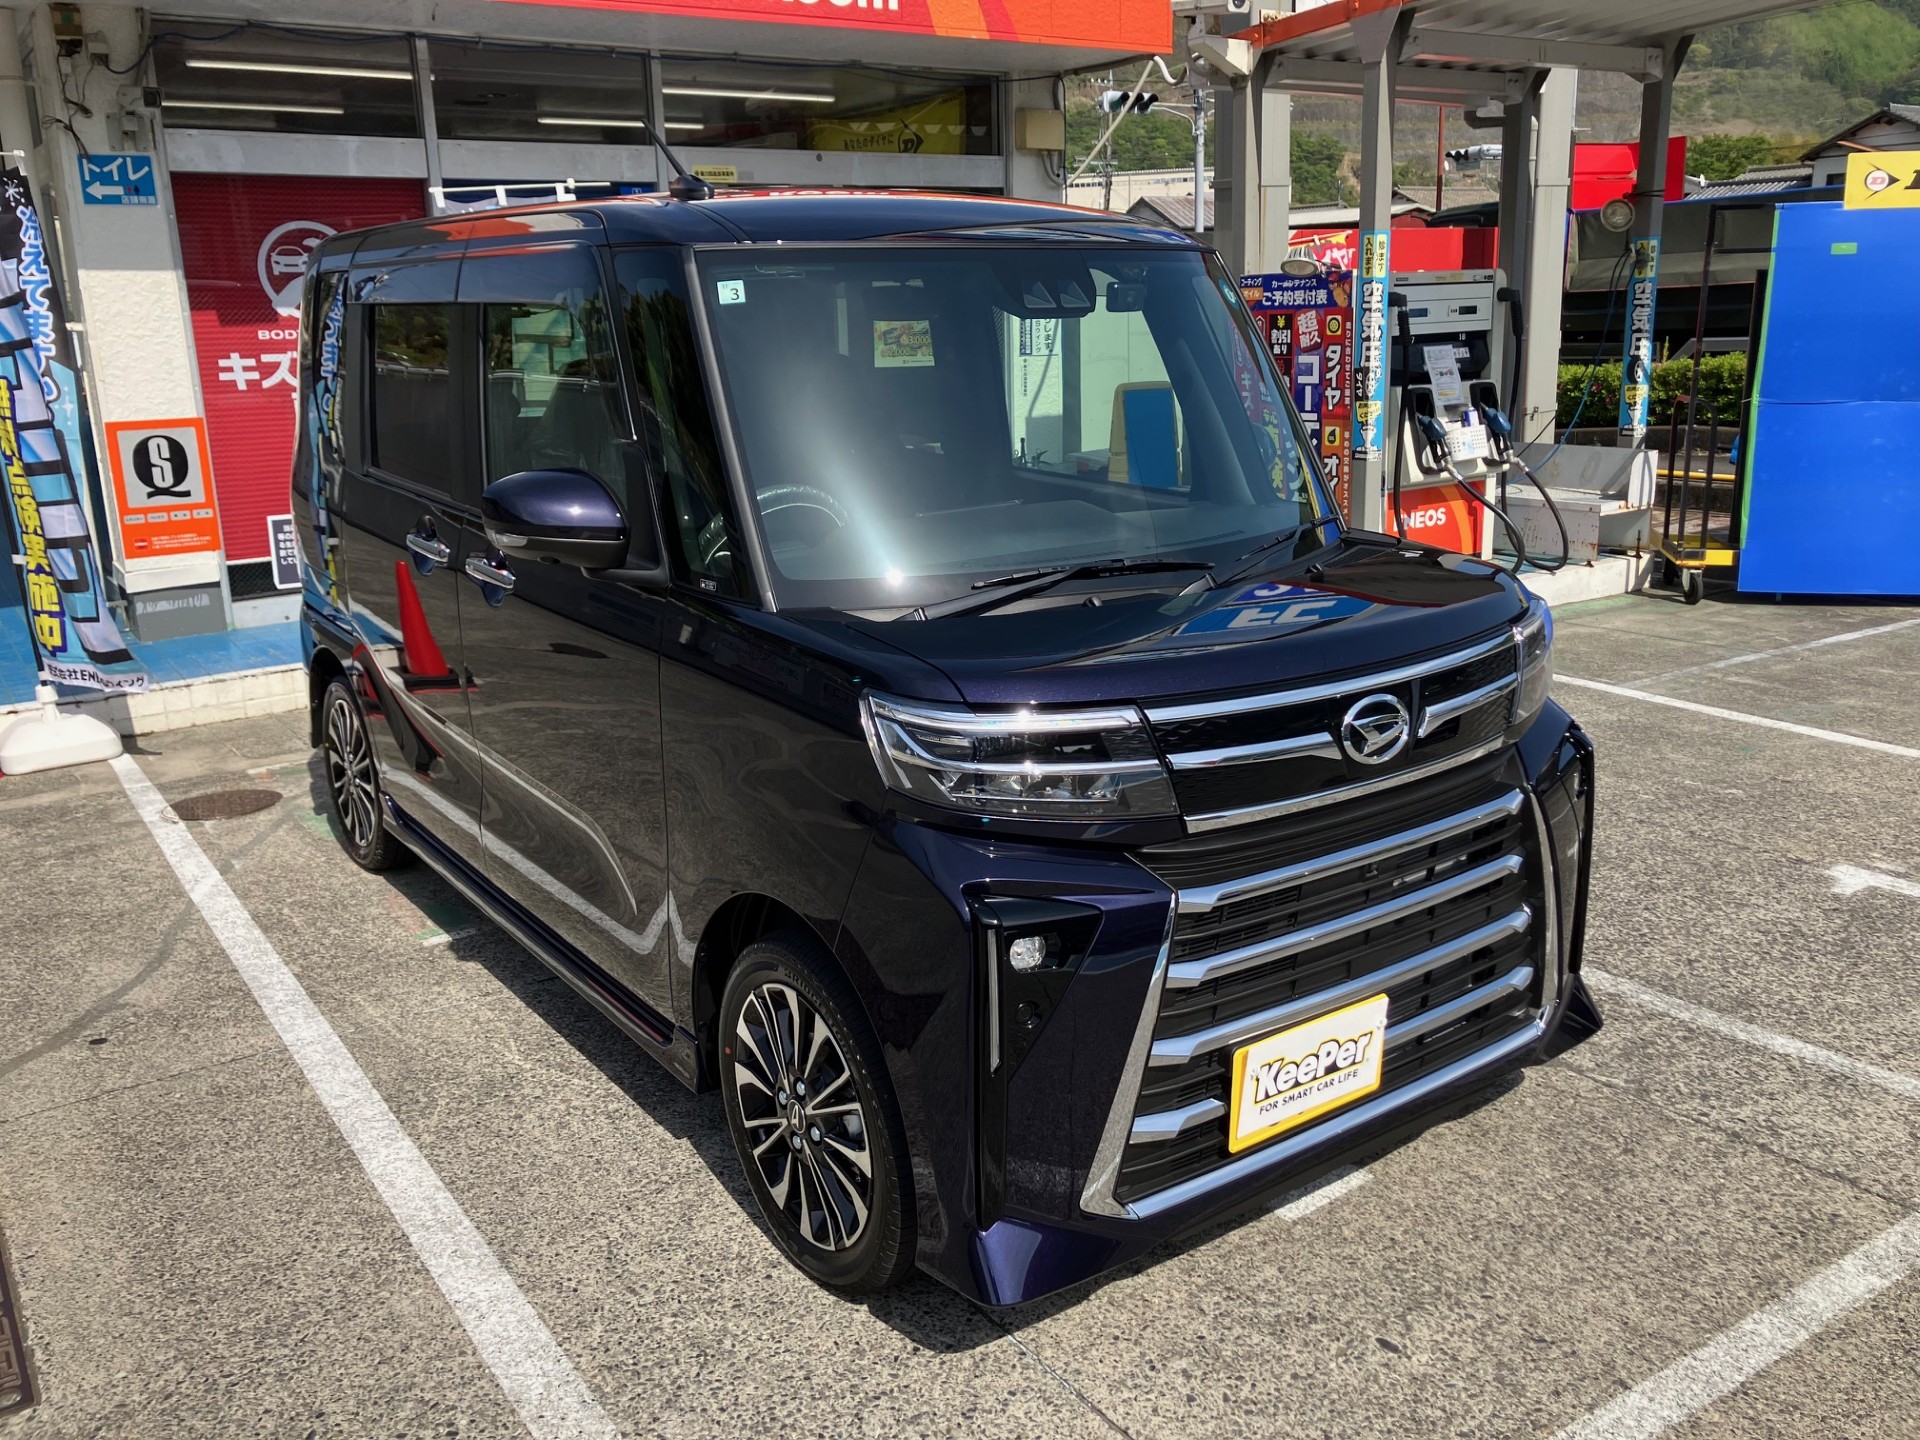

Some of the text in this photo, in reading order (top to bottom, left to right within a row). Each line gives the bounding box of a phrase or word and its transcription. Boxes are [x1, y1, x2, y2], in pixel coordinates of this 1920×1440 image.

[82, 156, 150, 181] トイレ
[729, 287, 740, 301] 3
[257, 329, 299, 340] BOD
[1297, 309, 1319, 335] 超
[1270, 328, 1291, 344] 割引
[1299, 330, 1322, 350] 耐久
[1324, 344, 1342, 410] タイヤ
[1255, 1031, 1373, 1104] KeePer
[1259, 1068, 1359, 1115] FOR SMART CAR LIFE
